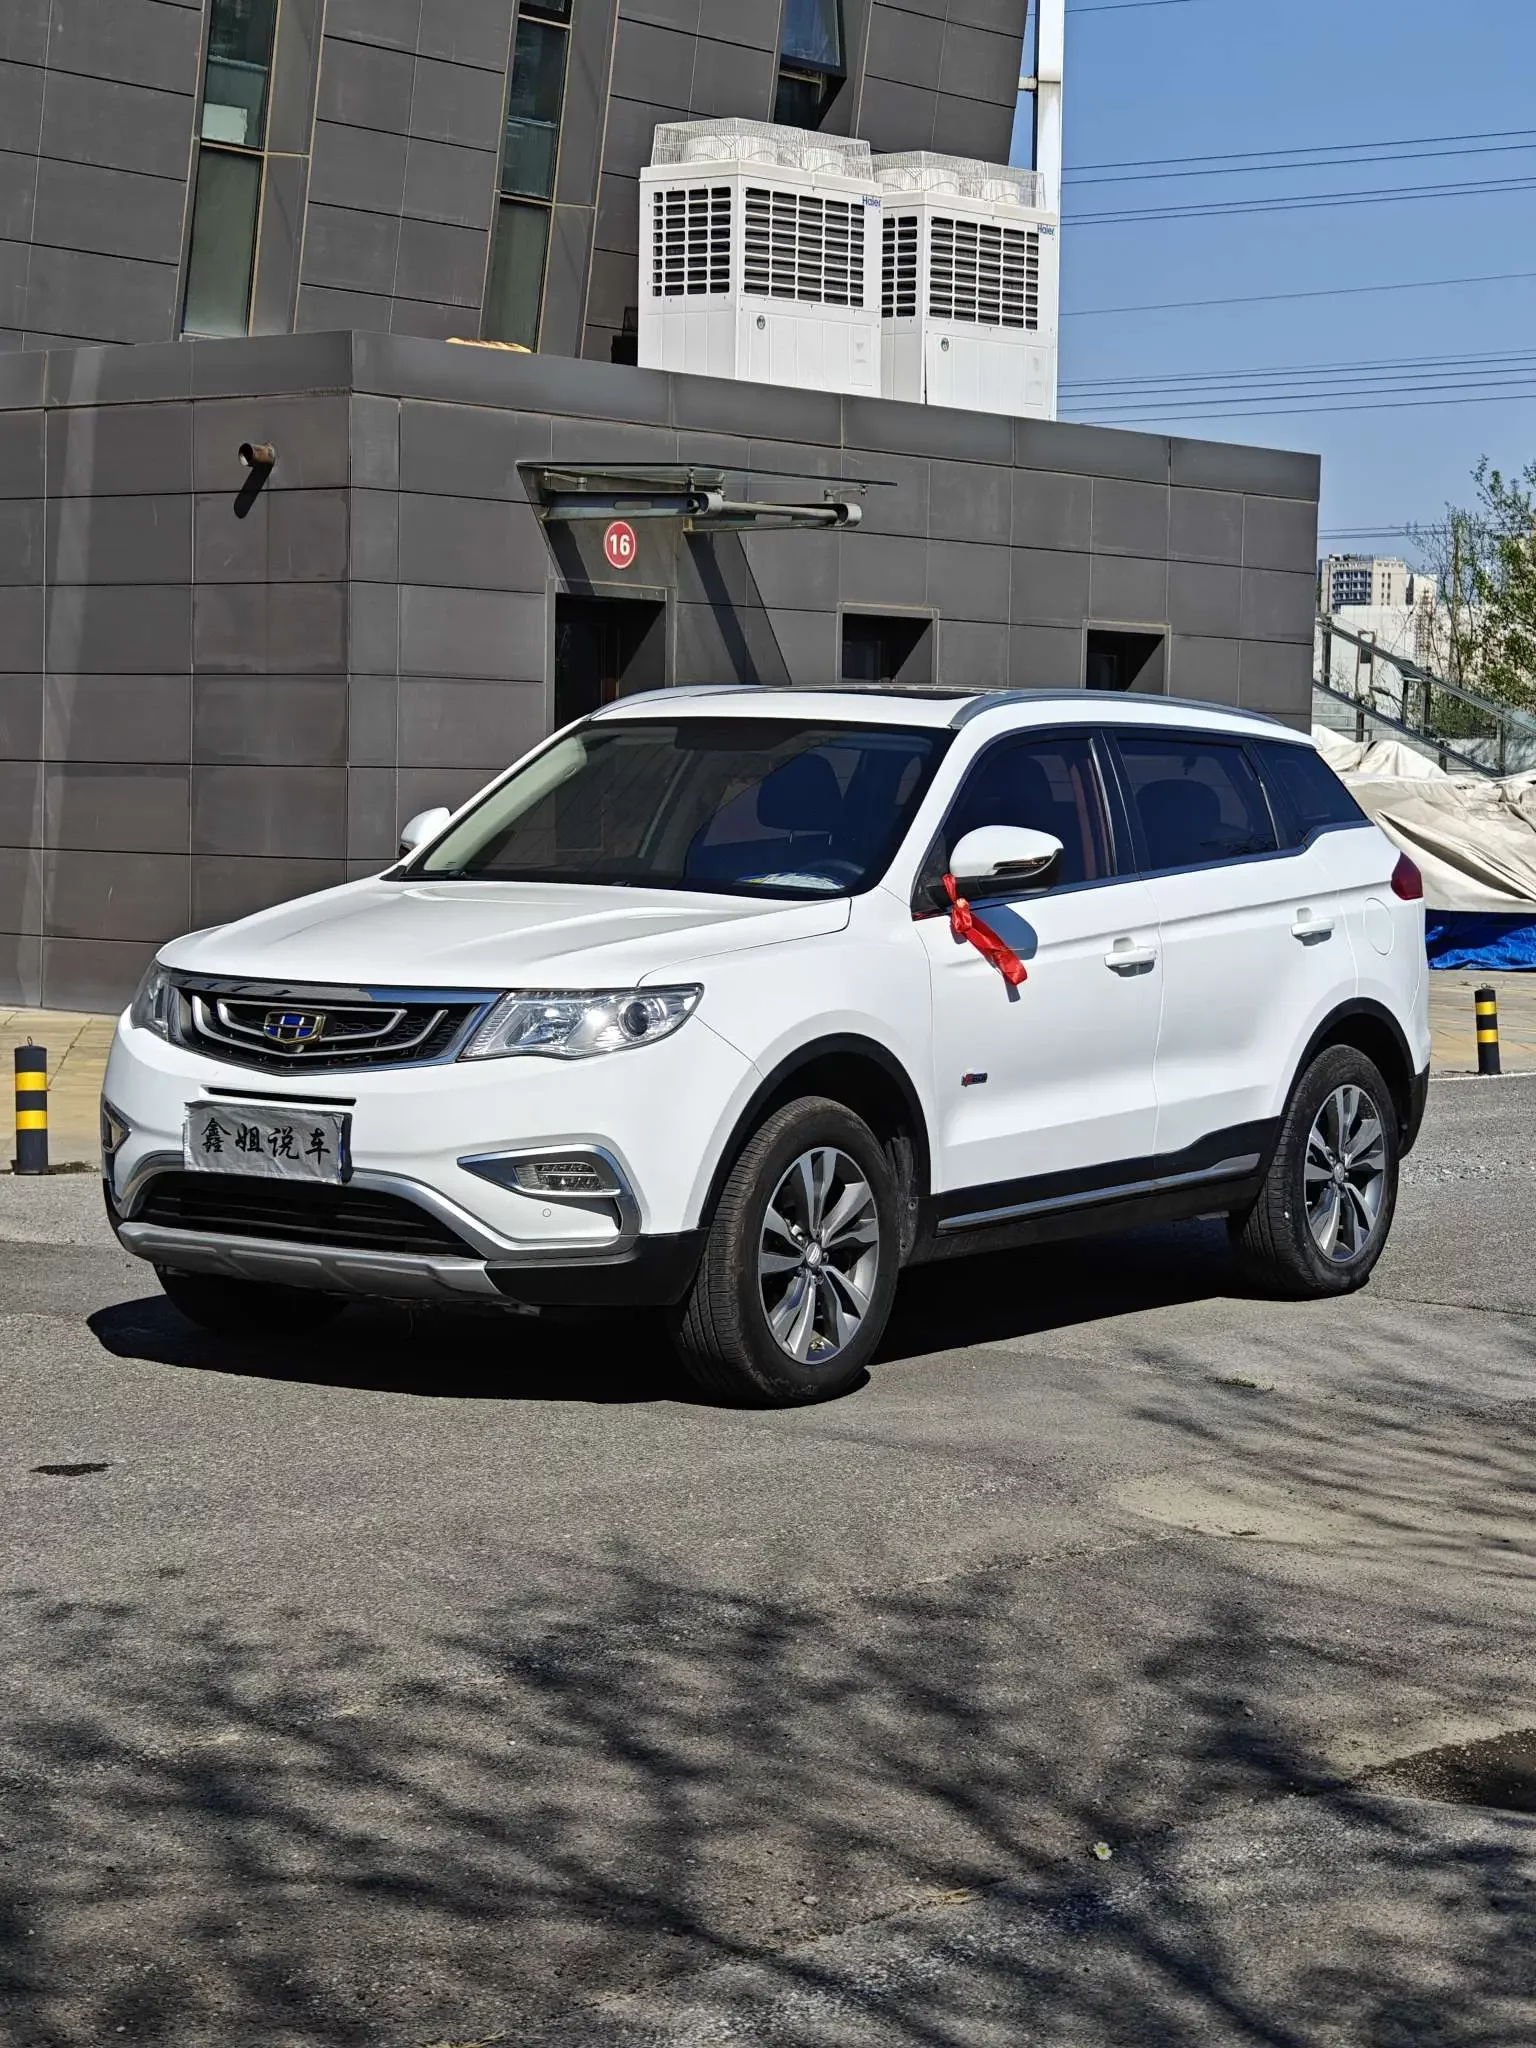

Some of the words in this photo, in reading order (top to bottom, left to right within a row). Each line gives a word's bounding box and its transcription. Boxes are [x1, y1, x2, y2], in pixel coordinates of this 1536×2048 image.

[861, 195, 881, 207] Haier
[1037, 224, 1055, 236] Haier
[609, 534, 631, 556] 16
[201, 1117, 331, 1165] 鑫姐说车
